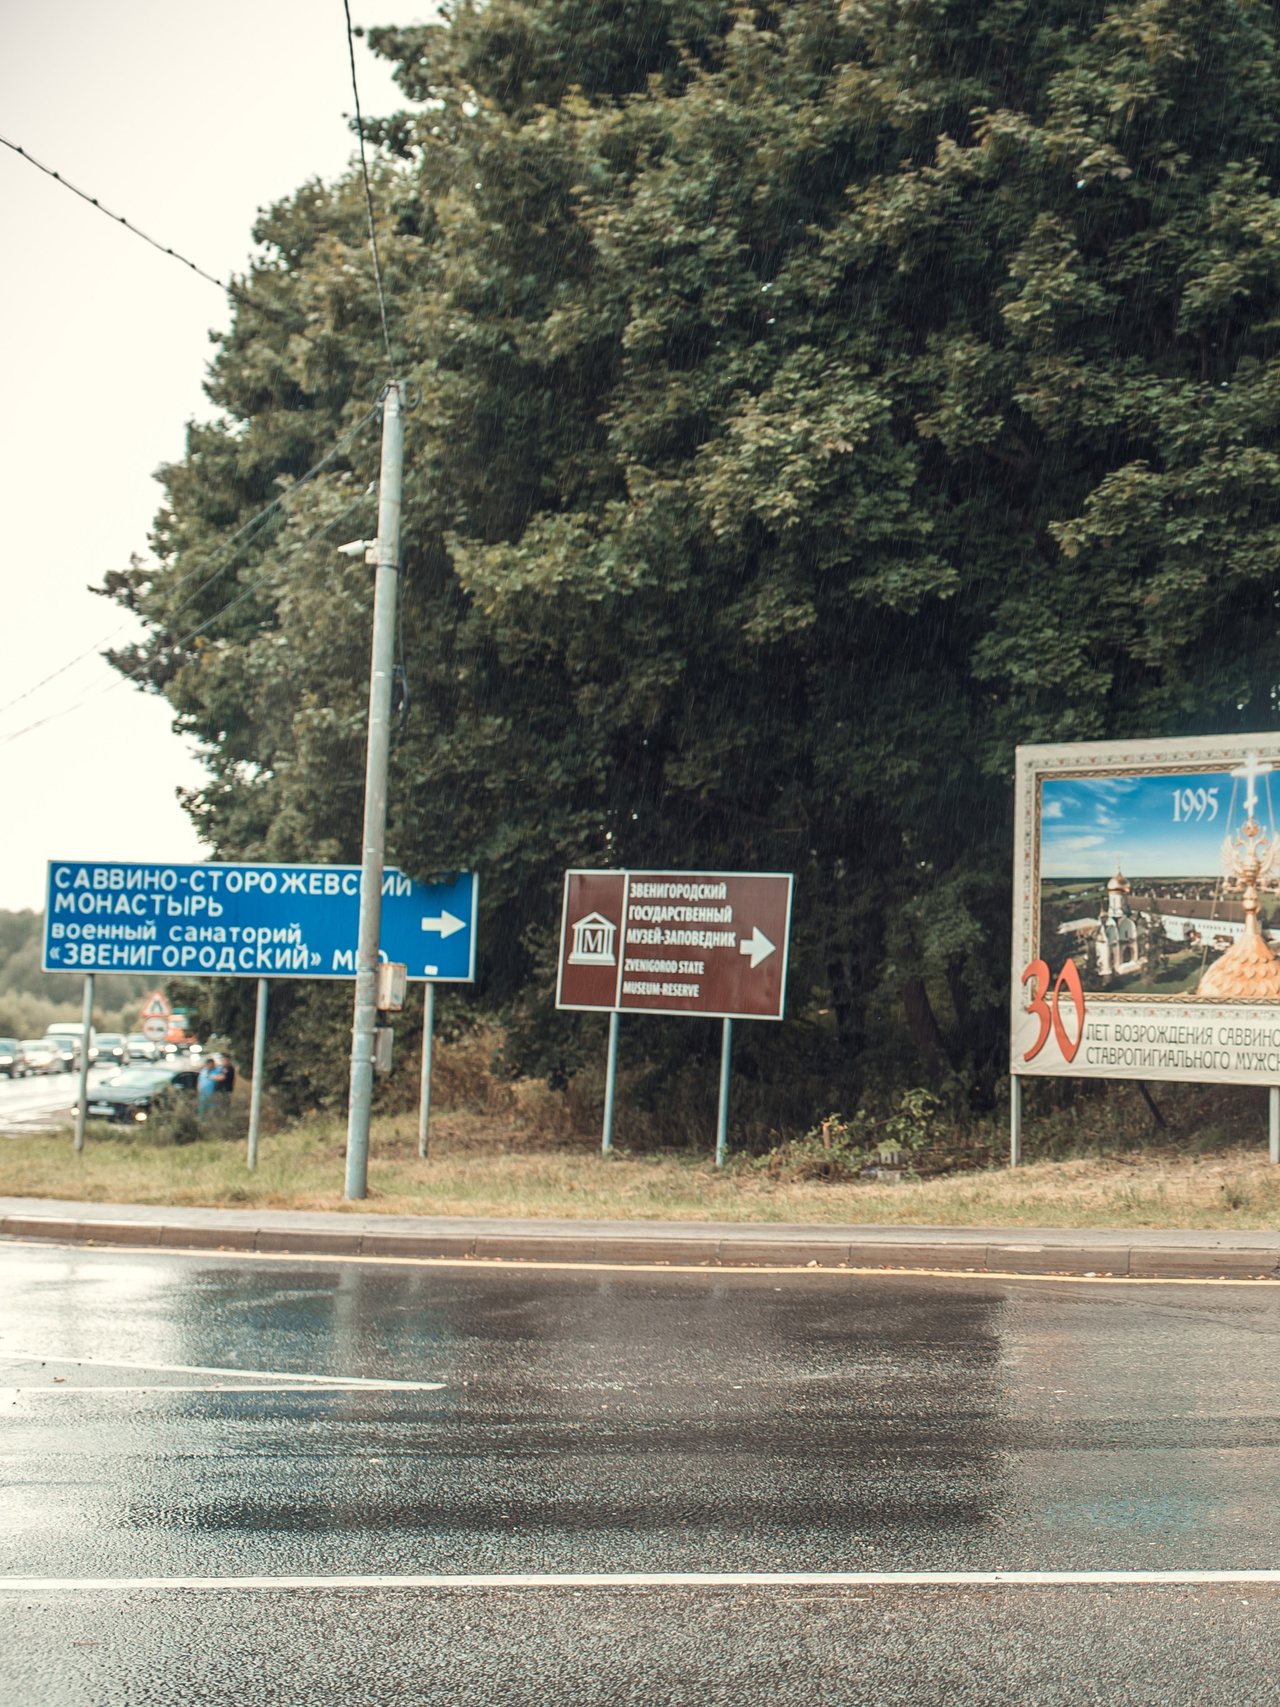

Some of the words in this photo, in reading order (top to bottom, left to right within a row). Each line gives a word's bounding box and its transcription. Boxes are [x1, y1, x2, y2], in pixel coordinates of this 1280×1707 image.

[1172, 787, 1219, 822] 1995
[54, 867, 412, 897] САВВИНО-СТОРОЖЕВСИЙ
[629, 882, 727, 901] ЗВЕНИГОРОДСКИЙ
[54, 893, 224, 917] МОНАСТЫРЬ
[628, 905, 733, 923] ГОСУДАРСТВЕННЫЙ
[52, 920, 157, 941] военный
[168, 922, 302, 945] санаторий
[626, 927, 737, 949] МУЗЕЙ-ЗАПОВЕДНИК
[50, 943, 321, 971] «ЗВЕНИГОРОДСКИЙ»
[624, 958, 678, 974] ZVENIGOROD
[678, 960, 705, 975] STATE
[623, 981, 700, 997] MUSEUM-RESERVE
[1021, 958, 1085, 1063] 30
[1086, 1024, 1110, 1041] ЛЕТ
[1114, 1024, 1213, 1045] ВОЗРОЖДЕНИЯ
[1086, 1046, 1231, 1070] СТАВРОПИГИАЛЬНОГО
